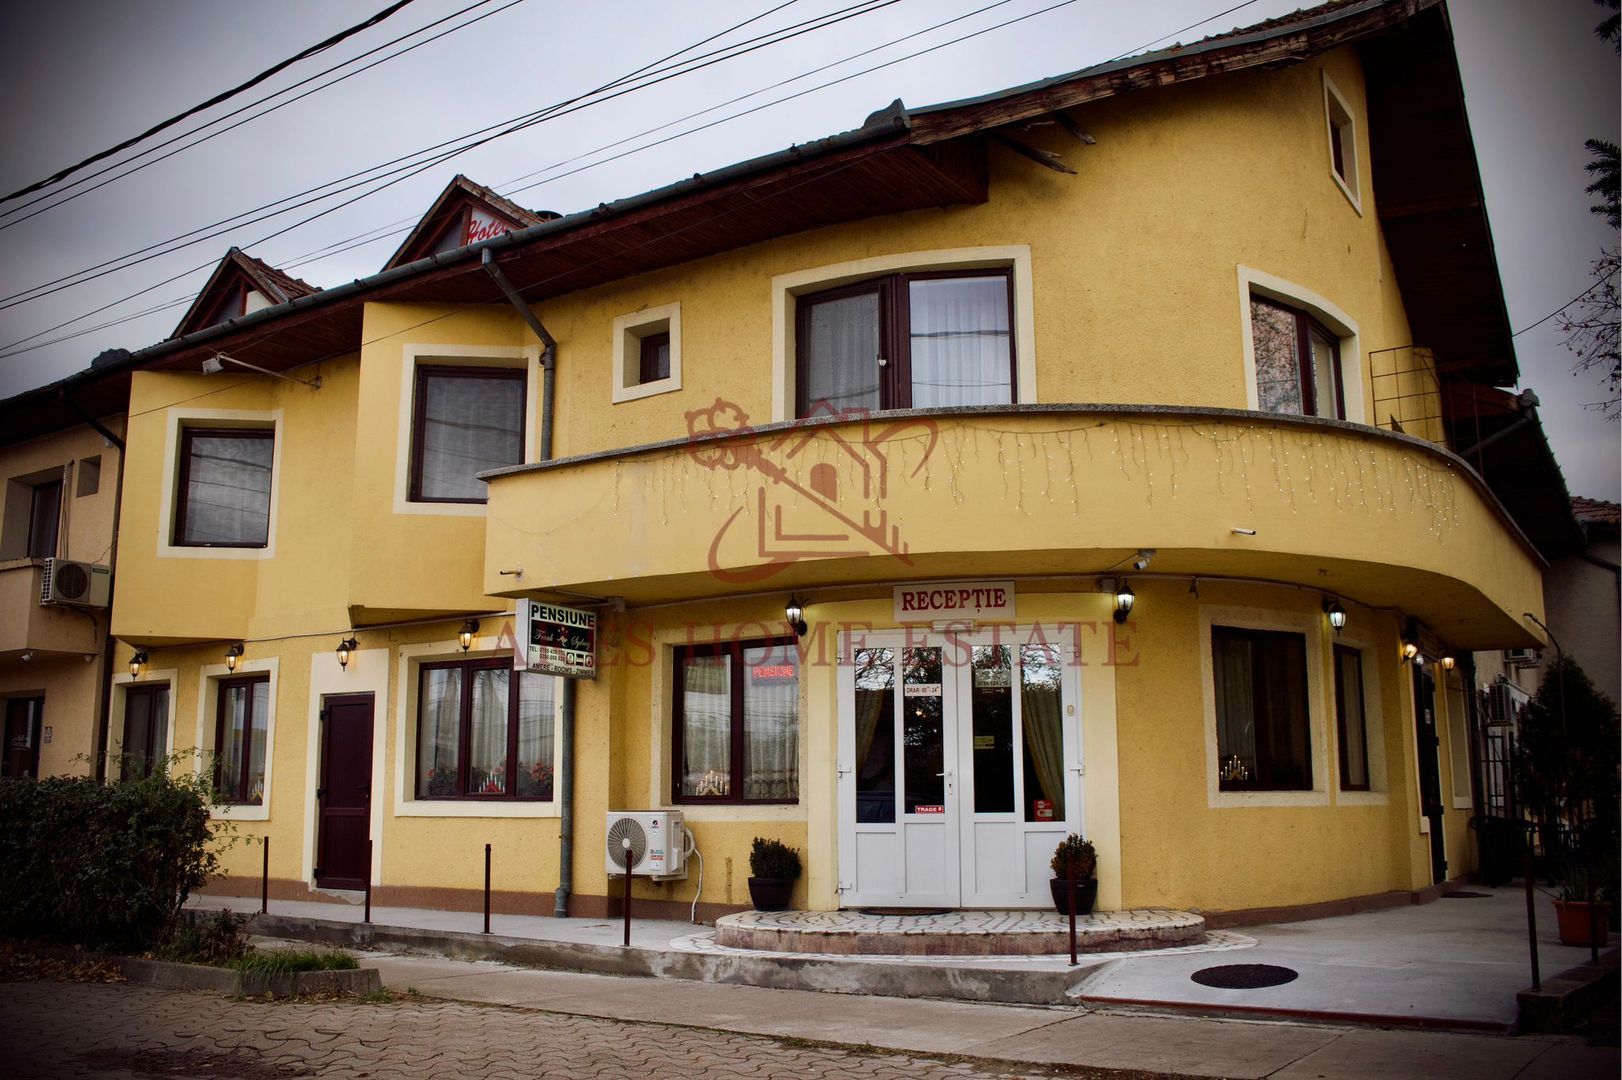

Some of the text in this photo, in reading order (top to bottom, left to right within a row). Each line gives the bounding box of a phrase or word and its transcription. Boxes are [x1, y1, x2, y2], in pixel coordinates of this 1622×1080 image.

[531, 604, 595, 628] PENSIUNE
[554, 665, 573, 674] ROOMS
[752, 665, 794, 678] PENSIUNE
